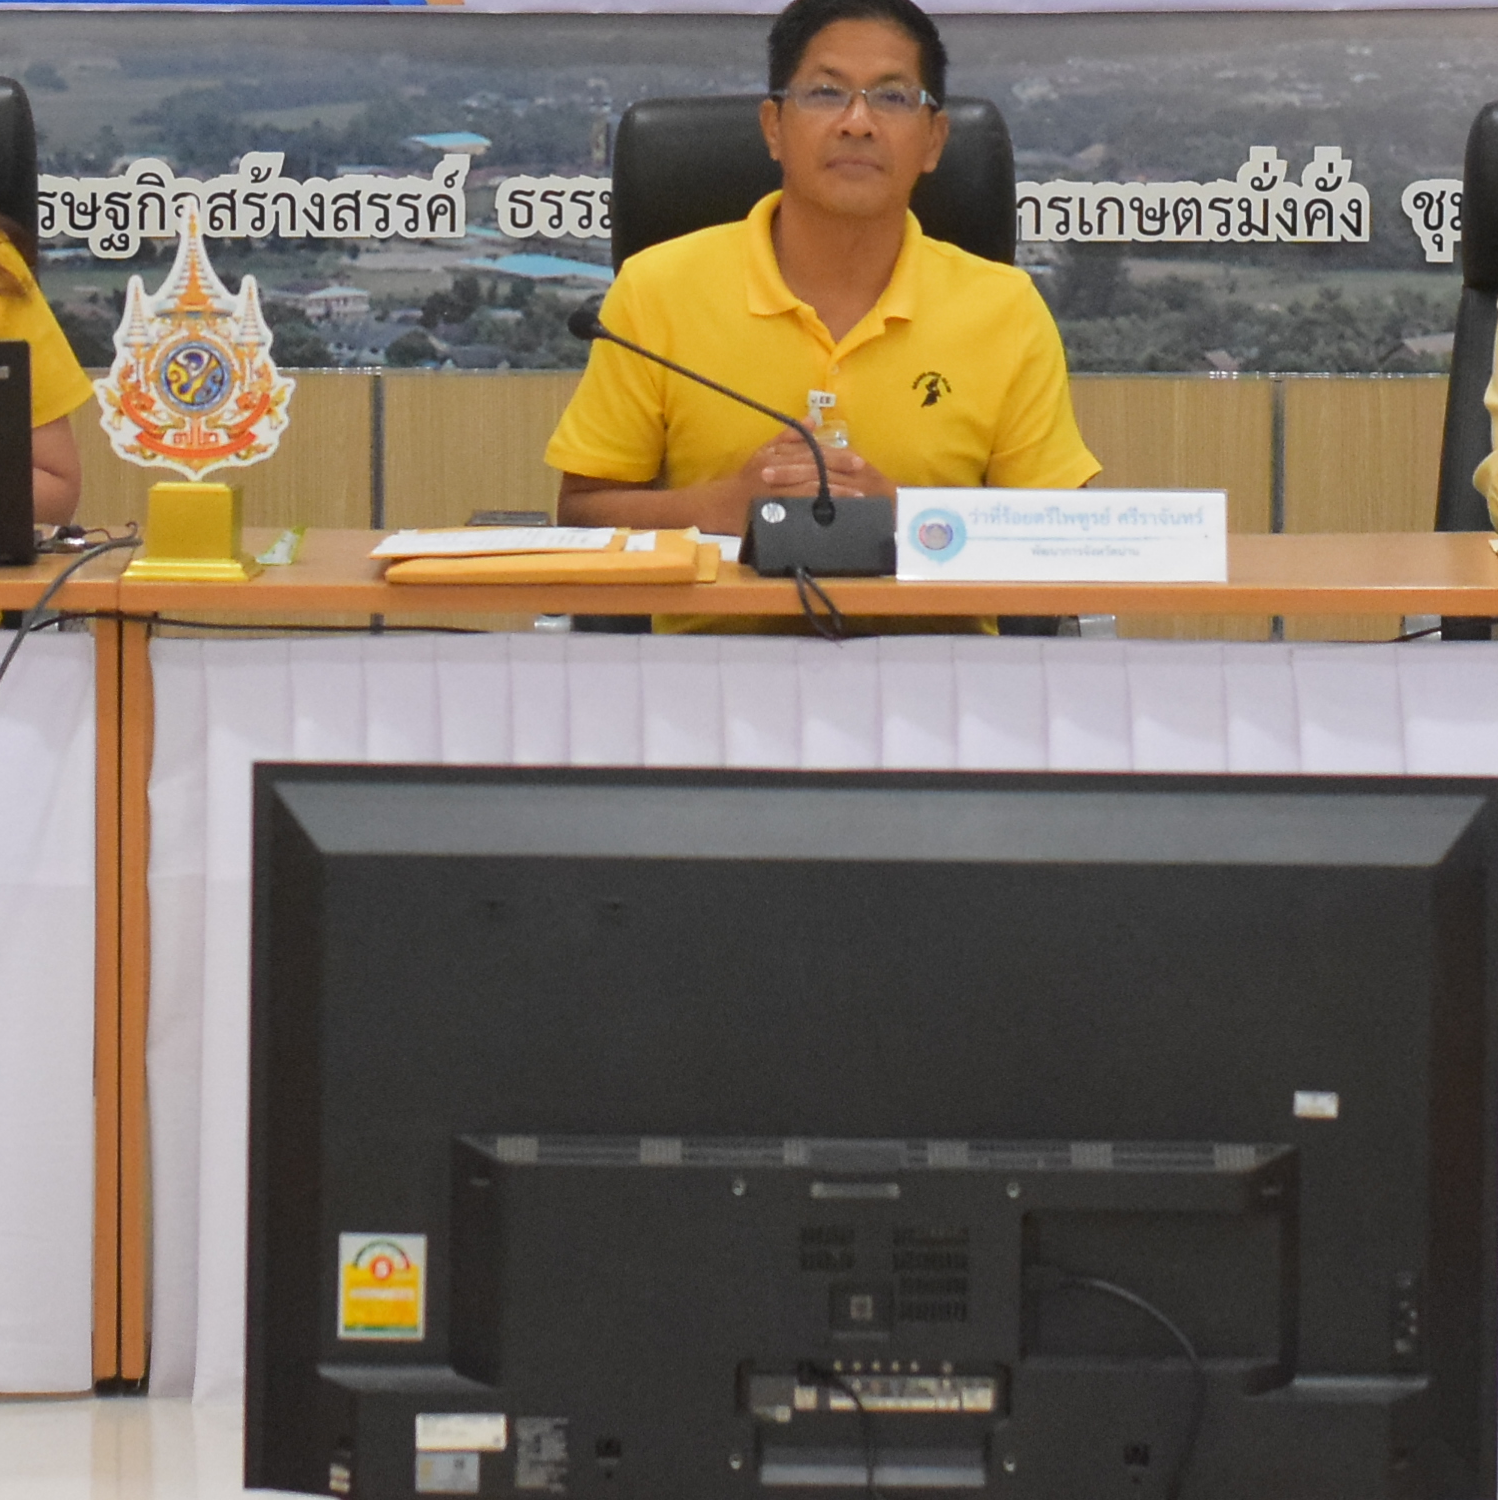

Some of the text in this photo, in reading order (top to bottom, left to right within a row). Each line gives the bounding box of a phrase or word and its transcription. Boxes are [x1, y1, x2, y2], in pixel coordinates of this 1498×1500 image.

[37, 165, 460, 252] รษฐกิสร้างสรรค์
[1016, 162, 1362, 237] ารเกษตรมั่งคั่ง
